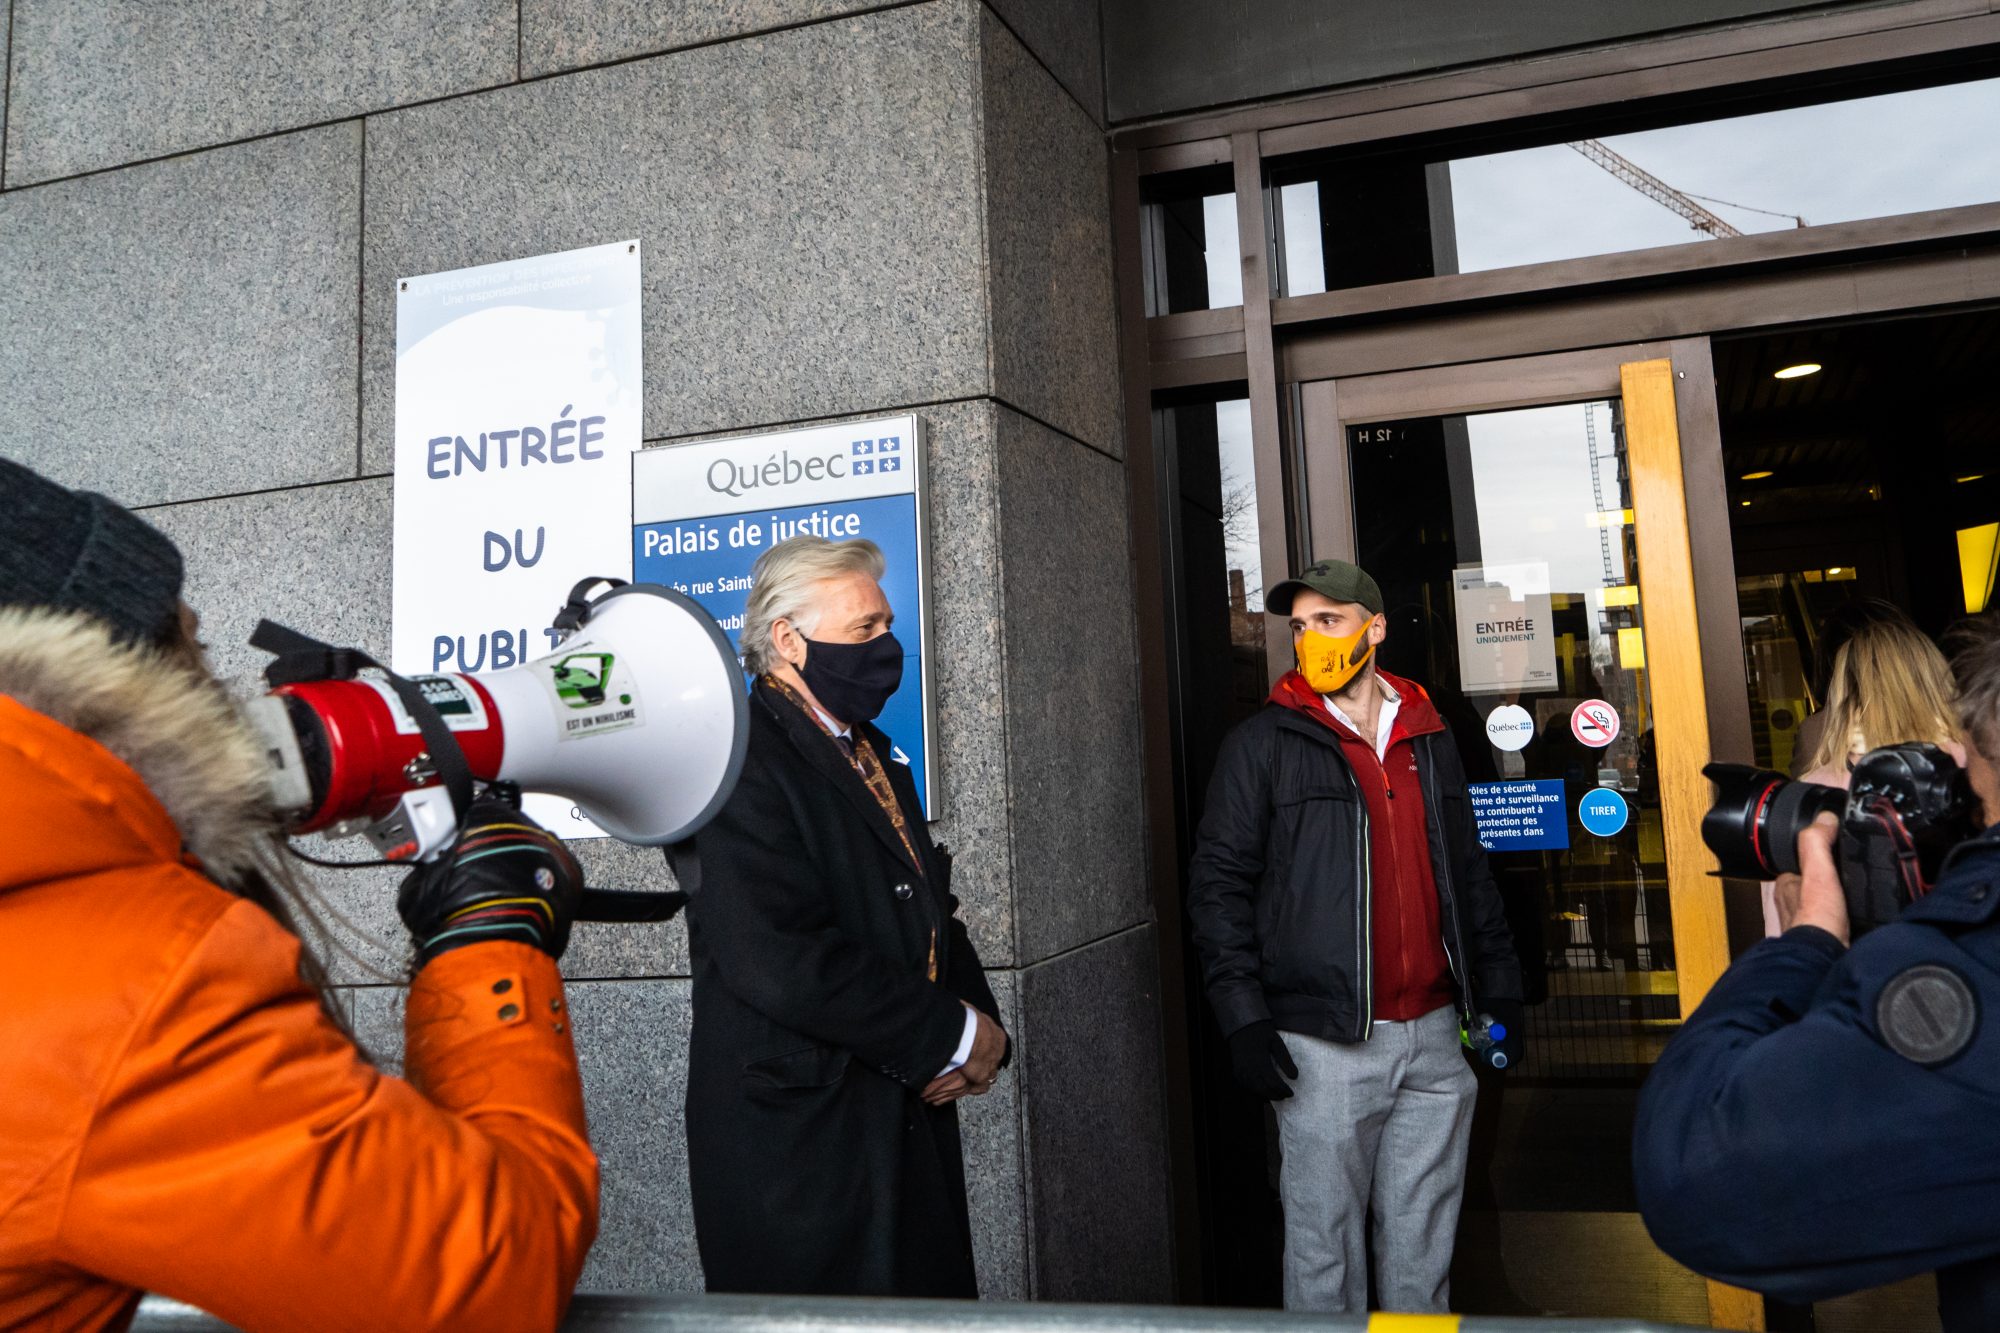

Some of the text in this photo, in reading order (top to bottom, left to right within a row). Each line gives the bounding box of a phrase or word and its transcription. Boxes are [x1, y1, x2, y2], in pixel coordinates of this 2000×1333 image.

[442, 273, 592, 306] Une responsabilité collective
[427, 404, 606, 480] ENTRÉE
[706, 450, 846, 497] Québec
[644, 524, 720, 557] Palais
[729, 520, 761, 547] de
[484, 526, 545, 572] DU
[692, 582, 714, 595] rue
[1476, 617, 1534, 634] ENTRÉE
[1476, 633, 1535, 644] UNIQUEMENT
[1488, 722, 1520, 733] Québec
[1490, 785, 1501, 794] de
[1503, 783, 1537, 794] sécurité
[1495, 796, 1506, 805] de
[1508, 793, 1559, 804] surveillance
[1487, 806, 1536, 816] contribuent
[1537, 804, 1543, 814] à
[1589, 805, 1617, 816] TIRER
[1477, 816, 1538, 829] protection des
[1480, 827, 1544, 840] présentes dans
